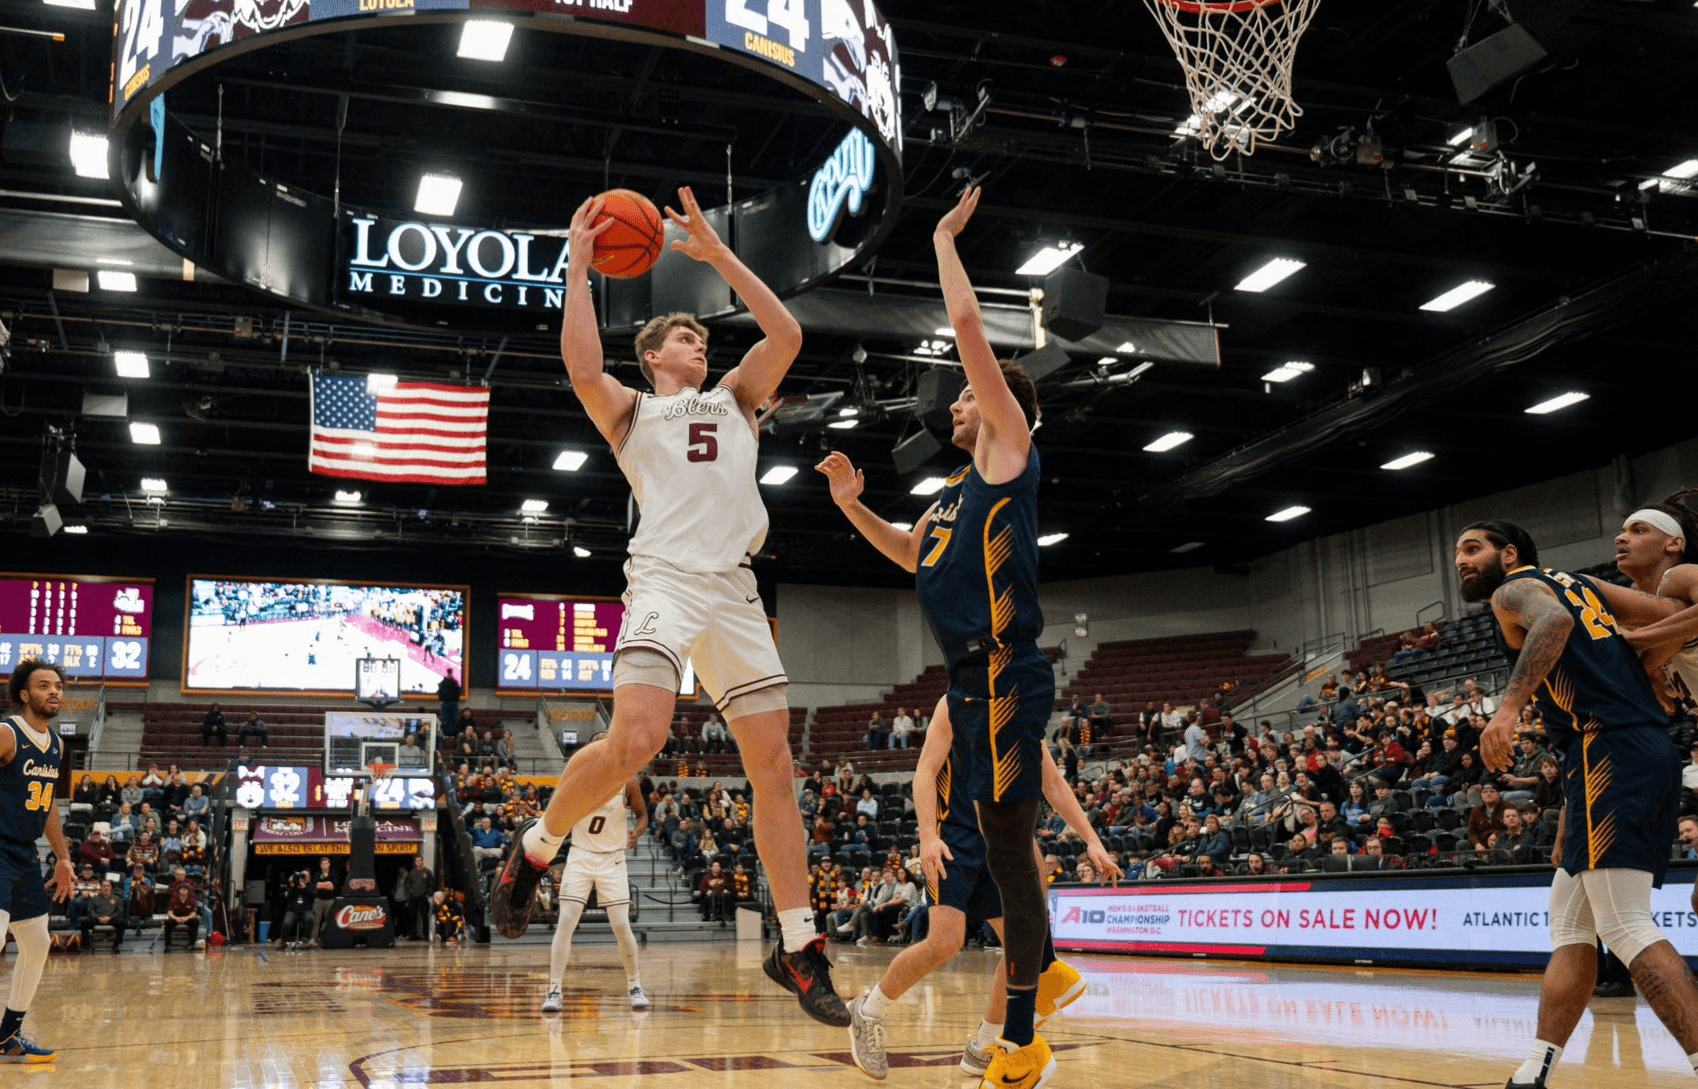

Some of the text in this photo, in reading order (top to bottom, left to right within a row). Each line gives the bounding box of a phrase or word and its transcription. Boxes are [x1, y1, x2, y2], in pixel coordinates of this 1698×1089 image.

[744, 31, 795, 67] CANISIUS
[350, 271, 564, 309] MEDICIN
[687, 423, 718, 463] 5
[921, 525, 953, 567] 7
[111, 641, 142, 669] 32
[504, 653, 532, 680] 24
[23, 759, 59, 779] Canisius
[25, 780, 54, 812] 34
[269, 773, 300, 802] 32
[374, 779, 405, 802] 24
[588, 815, 606, 835] 0
[260, 845, 275, 853] WE
[277, 844, 300, 853] ALSO
[303, 844, 328, 853] TREAT
[332, 844, 347, 853] THE
[386, 843, 413, 852] SPIRIT
[337, 904, 387, 928] Cane's
[1061, 906, 1105, 925] A10
[1106, 914, 1170, 925] CHAMPIONSHIP
[1178, 908, 1438, 931] TICKETS ON SALE NOW!
[1463, 911, 1540, 927] ATLANTIC
[1650, 911, 1698, 928] KETS
